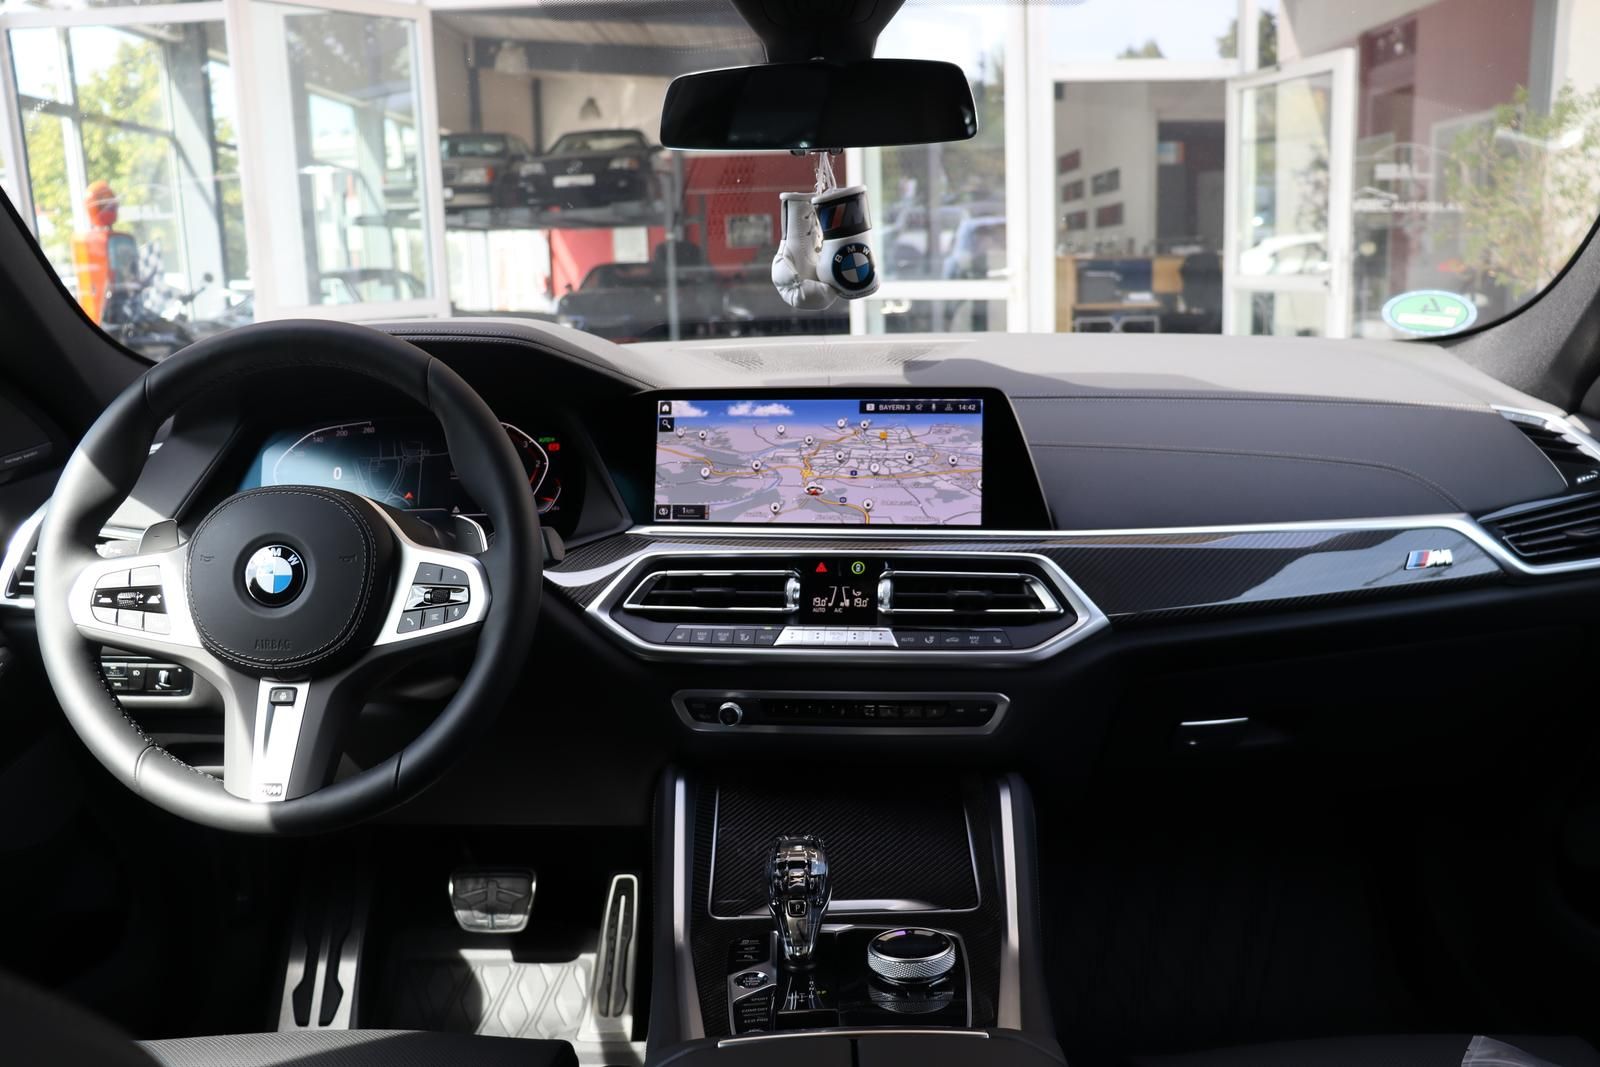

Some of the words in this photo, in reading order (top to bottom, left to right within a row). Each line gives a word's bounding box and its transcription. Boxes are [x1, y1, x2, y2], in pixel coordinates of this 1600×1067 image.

[834, 246, 871, 263] BMW
[878, 403, 905, 411] BAYERN
[905, 403, 911, 411] 3
[958, 403, 976, 411] 14:42
[333, 466, 342, 480] 0
[254, 639, 292, 650] AIRBAG
